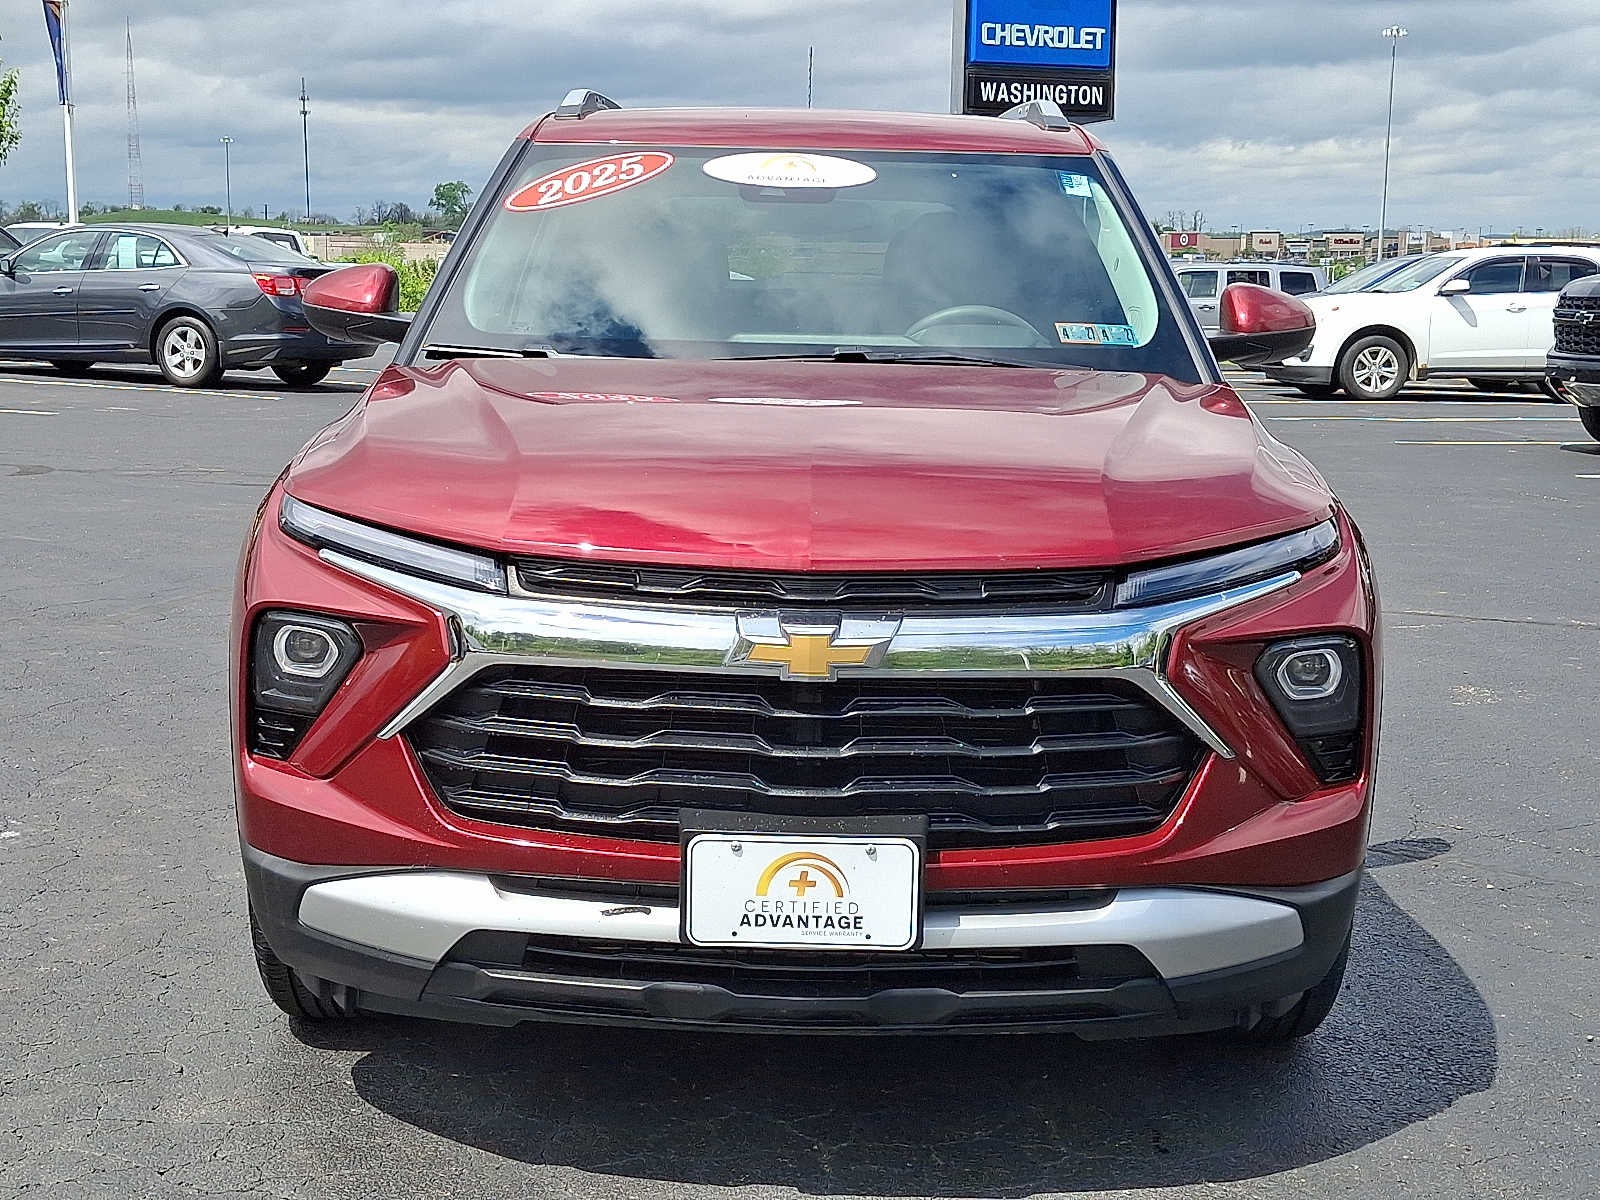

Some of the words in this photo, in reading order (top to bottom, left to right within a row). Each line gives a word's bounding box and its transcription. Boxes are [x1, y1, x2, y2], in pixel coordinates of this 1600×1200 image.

[981, 23, 1105, 49] CHEVROLET
[980, 81, 1104, 106] WASHINGTON
[537, 156, 644, 205] 2025
[744, 899, 859, 915] CERTIFIED
[739, 913, 864, 930] ADVANTAGE
